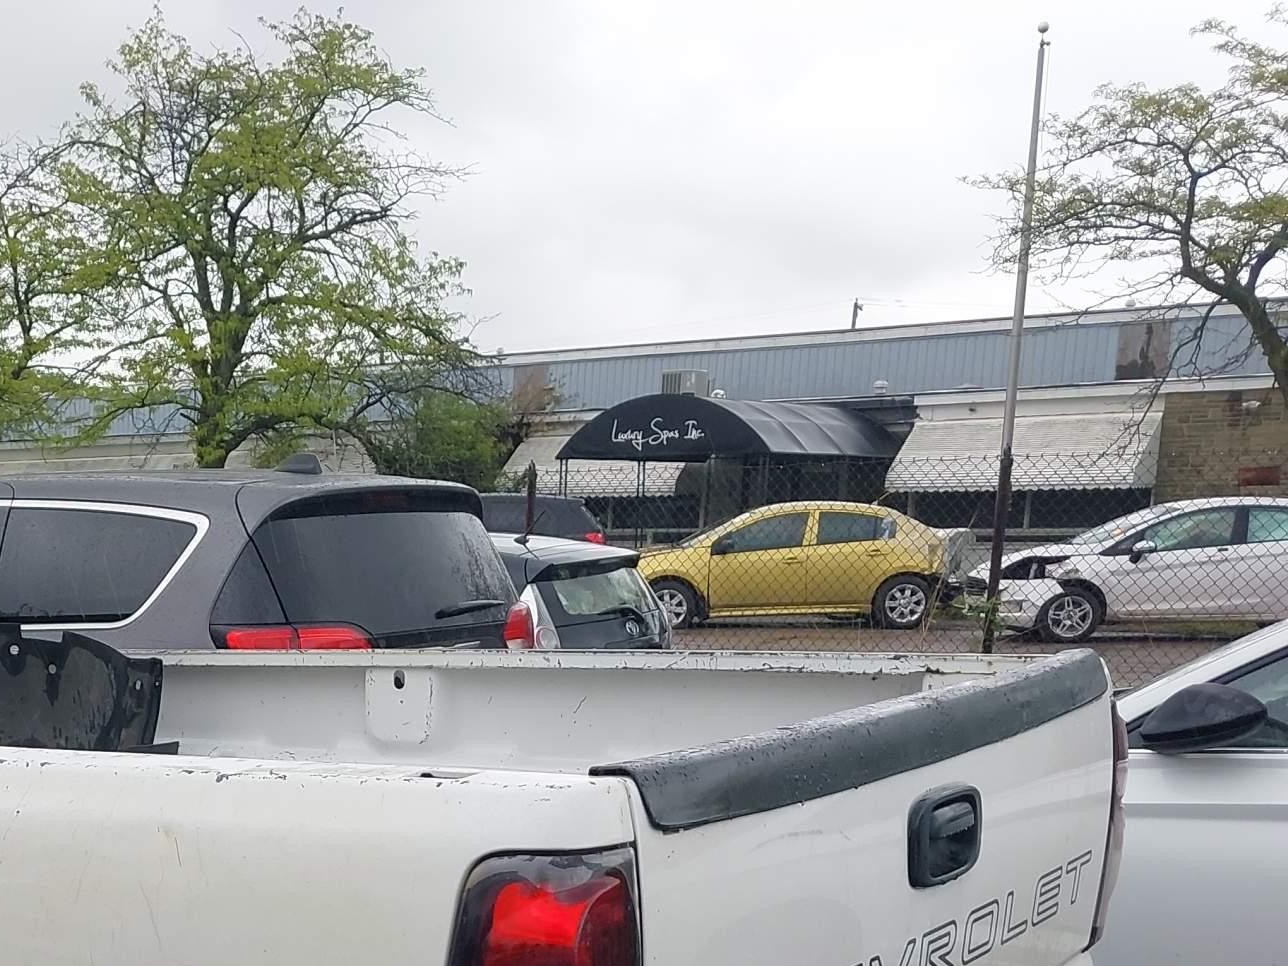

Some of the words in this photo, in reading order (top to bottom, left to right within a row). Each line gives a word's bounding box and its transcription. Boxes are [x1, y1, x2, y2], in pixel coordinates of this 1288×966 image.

[612, 418, 646, 451] Luxury
[649, 417, 680, 445] Spas
[684, 420, 705, 440] Inc.
